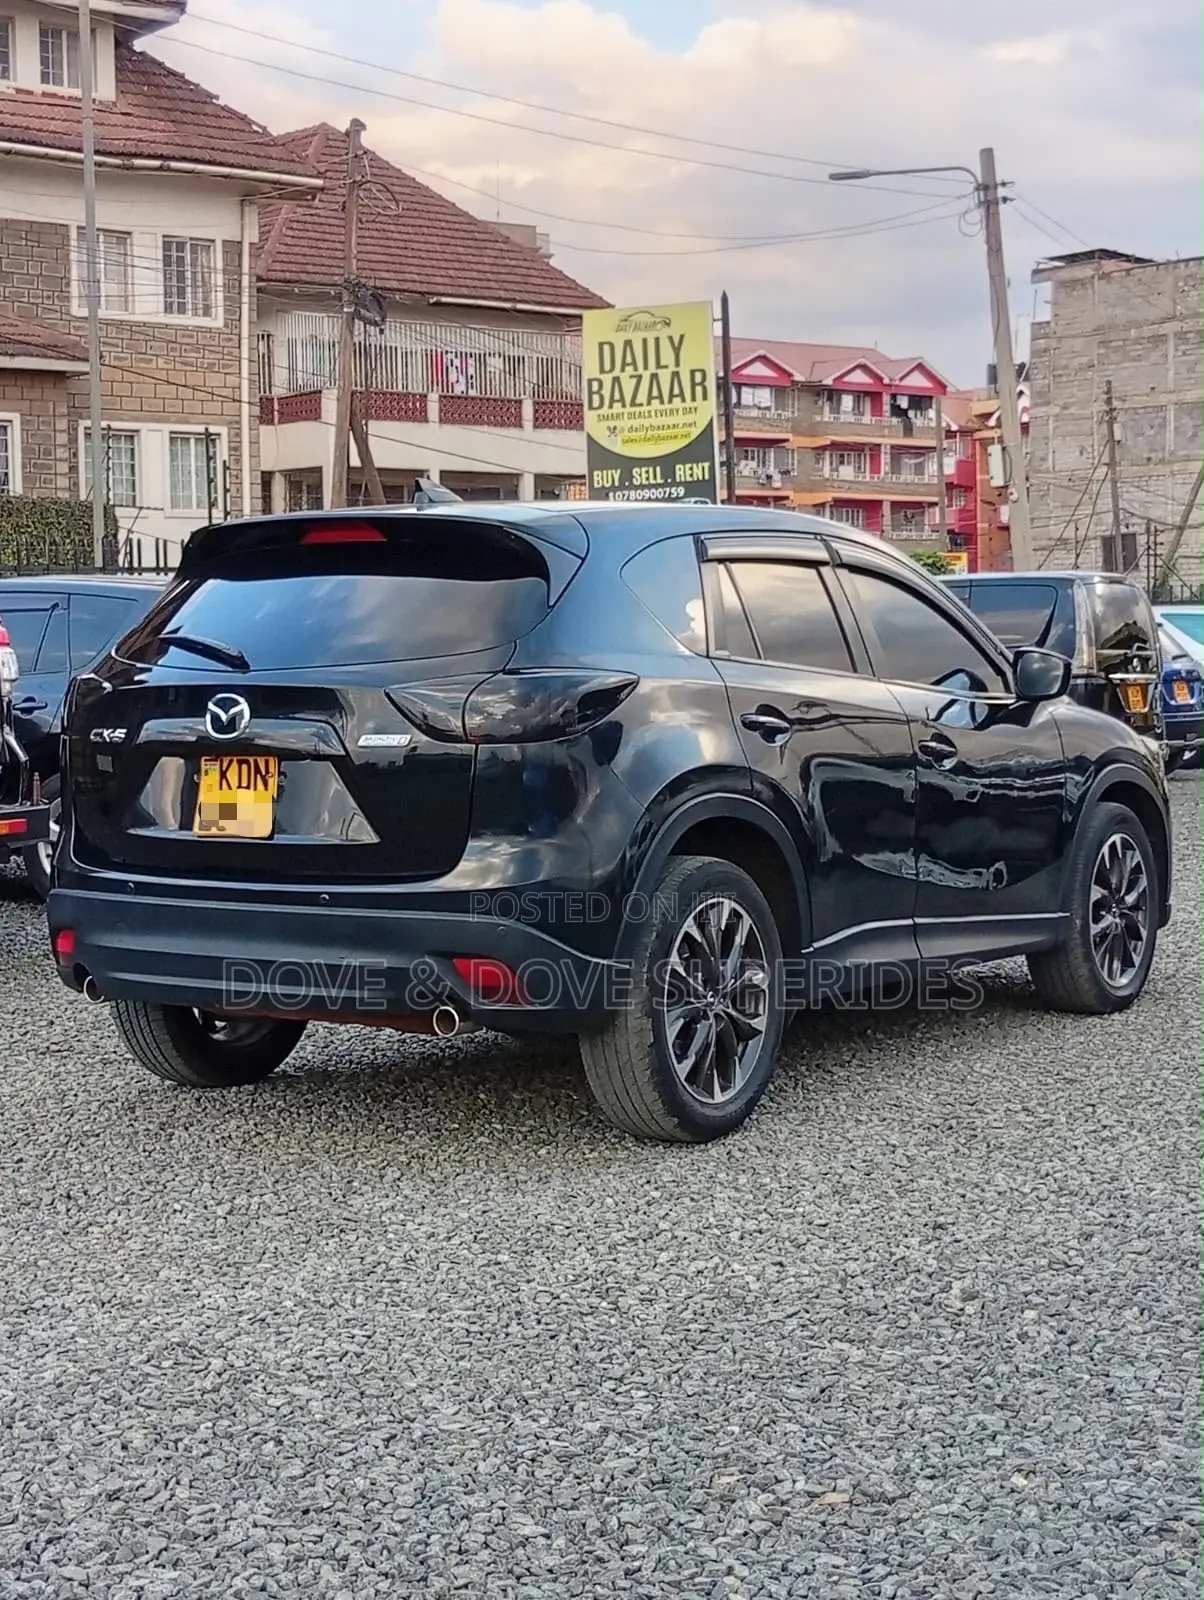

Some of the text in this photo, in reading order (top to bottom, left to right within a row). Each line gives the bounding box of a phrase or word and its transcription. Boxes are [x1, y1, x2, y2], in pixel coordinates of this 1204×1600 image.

[597, 333, 685, 375] DAILY
[586, 368, 708, 411] BAZAAR
[597, 406, 698, 422] SMART DEALS EVERY DAY
[593, 468, 621, 488] BUY
[632, 465, 664, 485] SELL
[675, 462, 710, 482] RENT
[90, 728, 128, 742] CX-5
[219, 757, 271, 792] KDN
